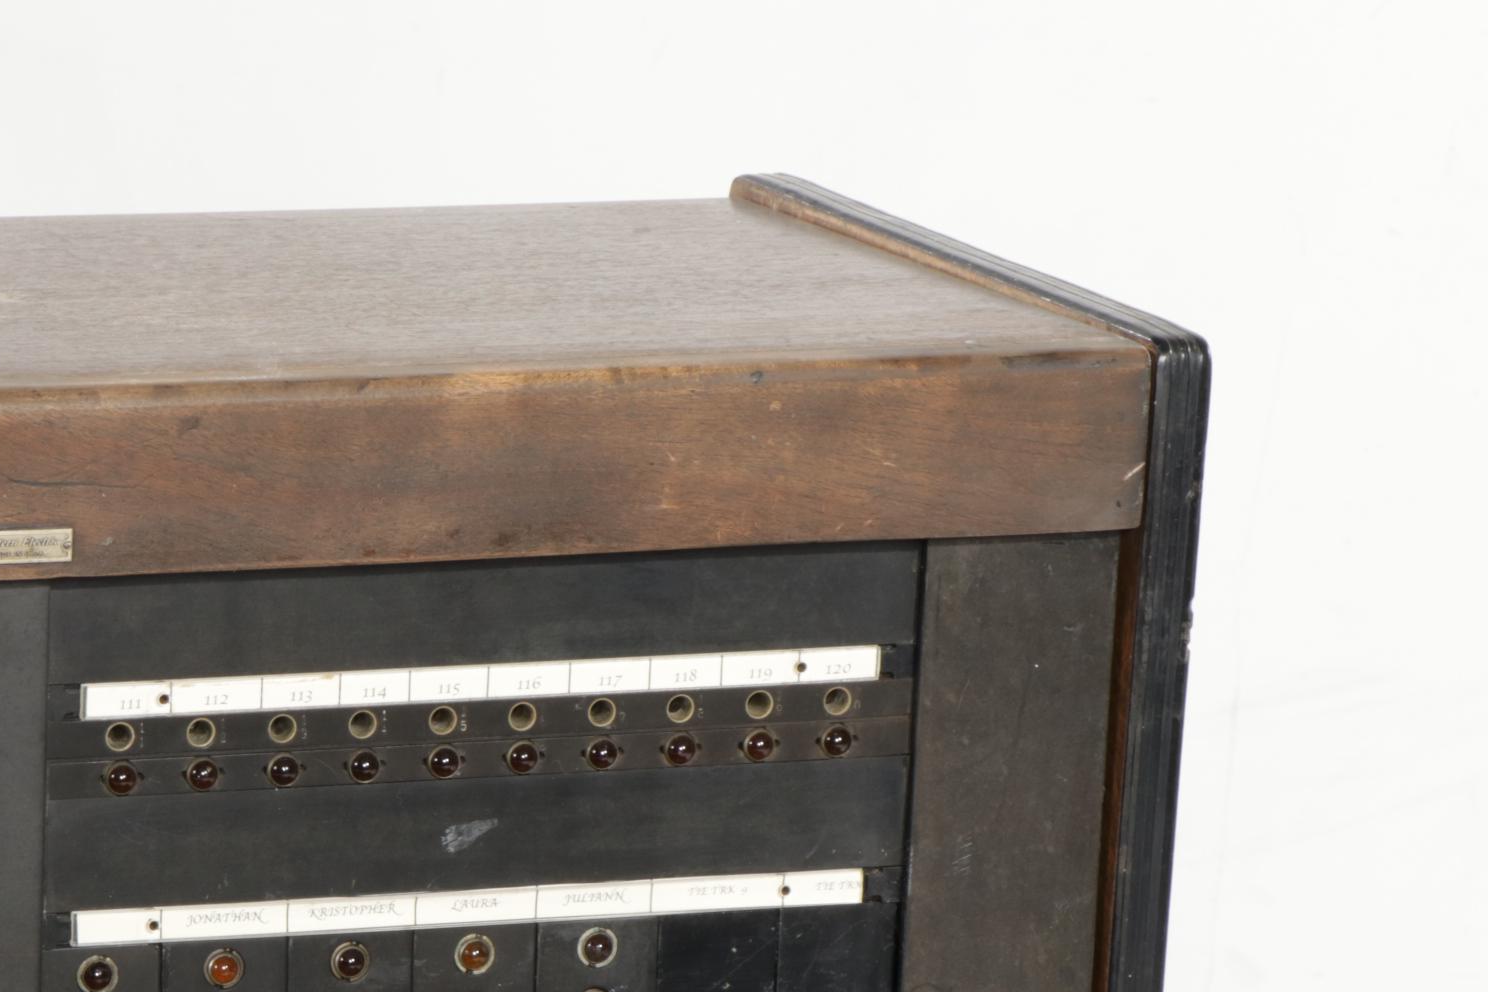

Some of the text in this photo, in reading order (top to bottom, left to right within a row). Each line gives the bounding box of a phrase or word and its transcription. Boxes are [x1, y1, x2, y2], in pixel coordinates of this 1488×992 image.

[674, 669, 698, 684] 118
[748, 667, 773, 681] 119
[825, 663, 852, 676] 120
[516, 676, 542, 690] 116
[598, 674, 623, 688] 117
[362, 686, 387, 699] 114
[438, 683, 461, 696] 115
[203, 694, 229, 706] 112
[289, 690, 313, 704] 113
[119, 698, 142, 711] 111
[451, 897, 499, 912] LAURA
[561, 890, 631, 906] JULIANN
[185, 909, 269, 927] JONATHAN
[308, 902, 406, 920] KRISTOPHER
